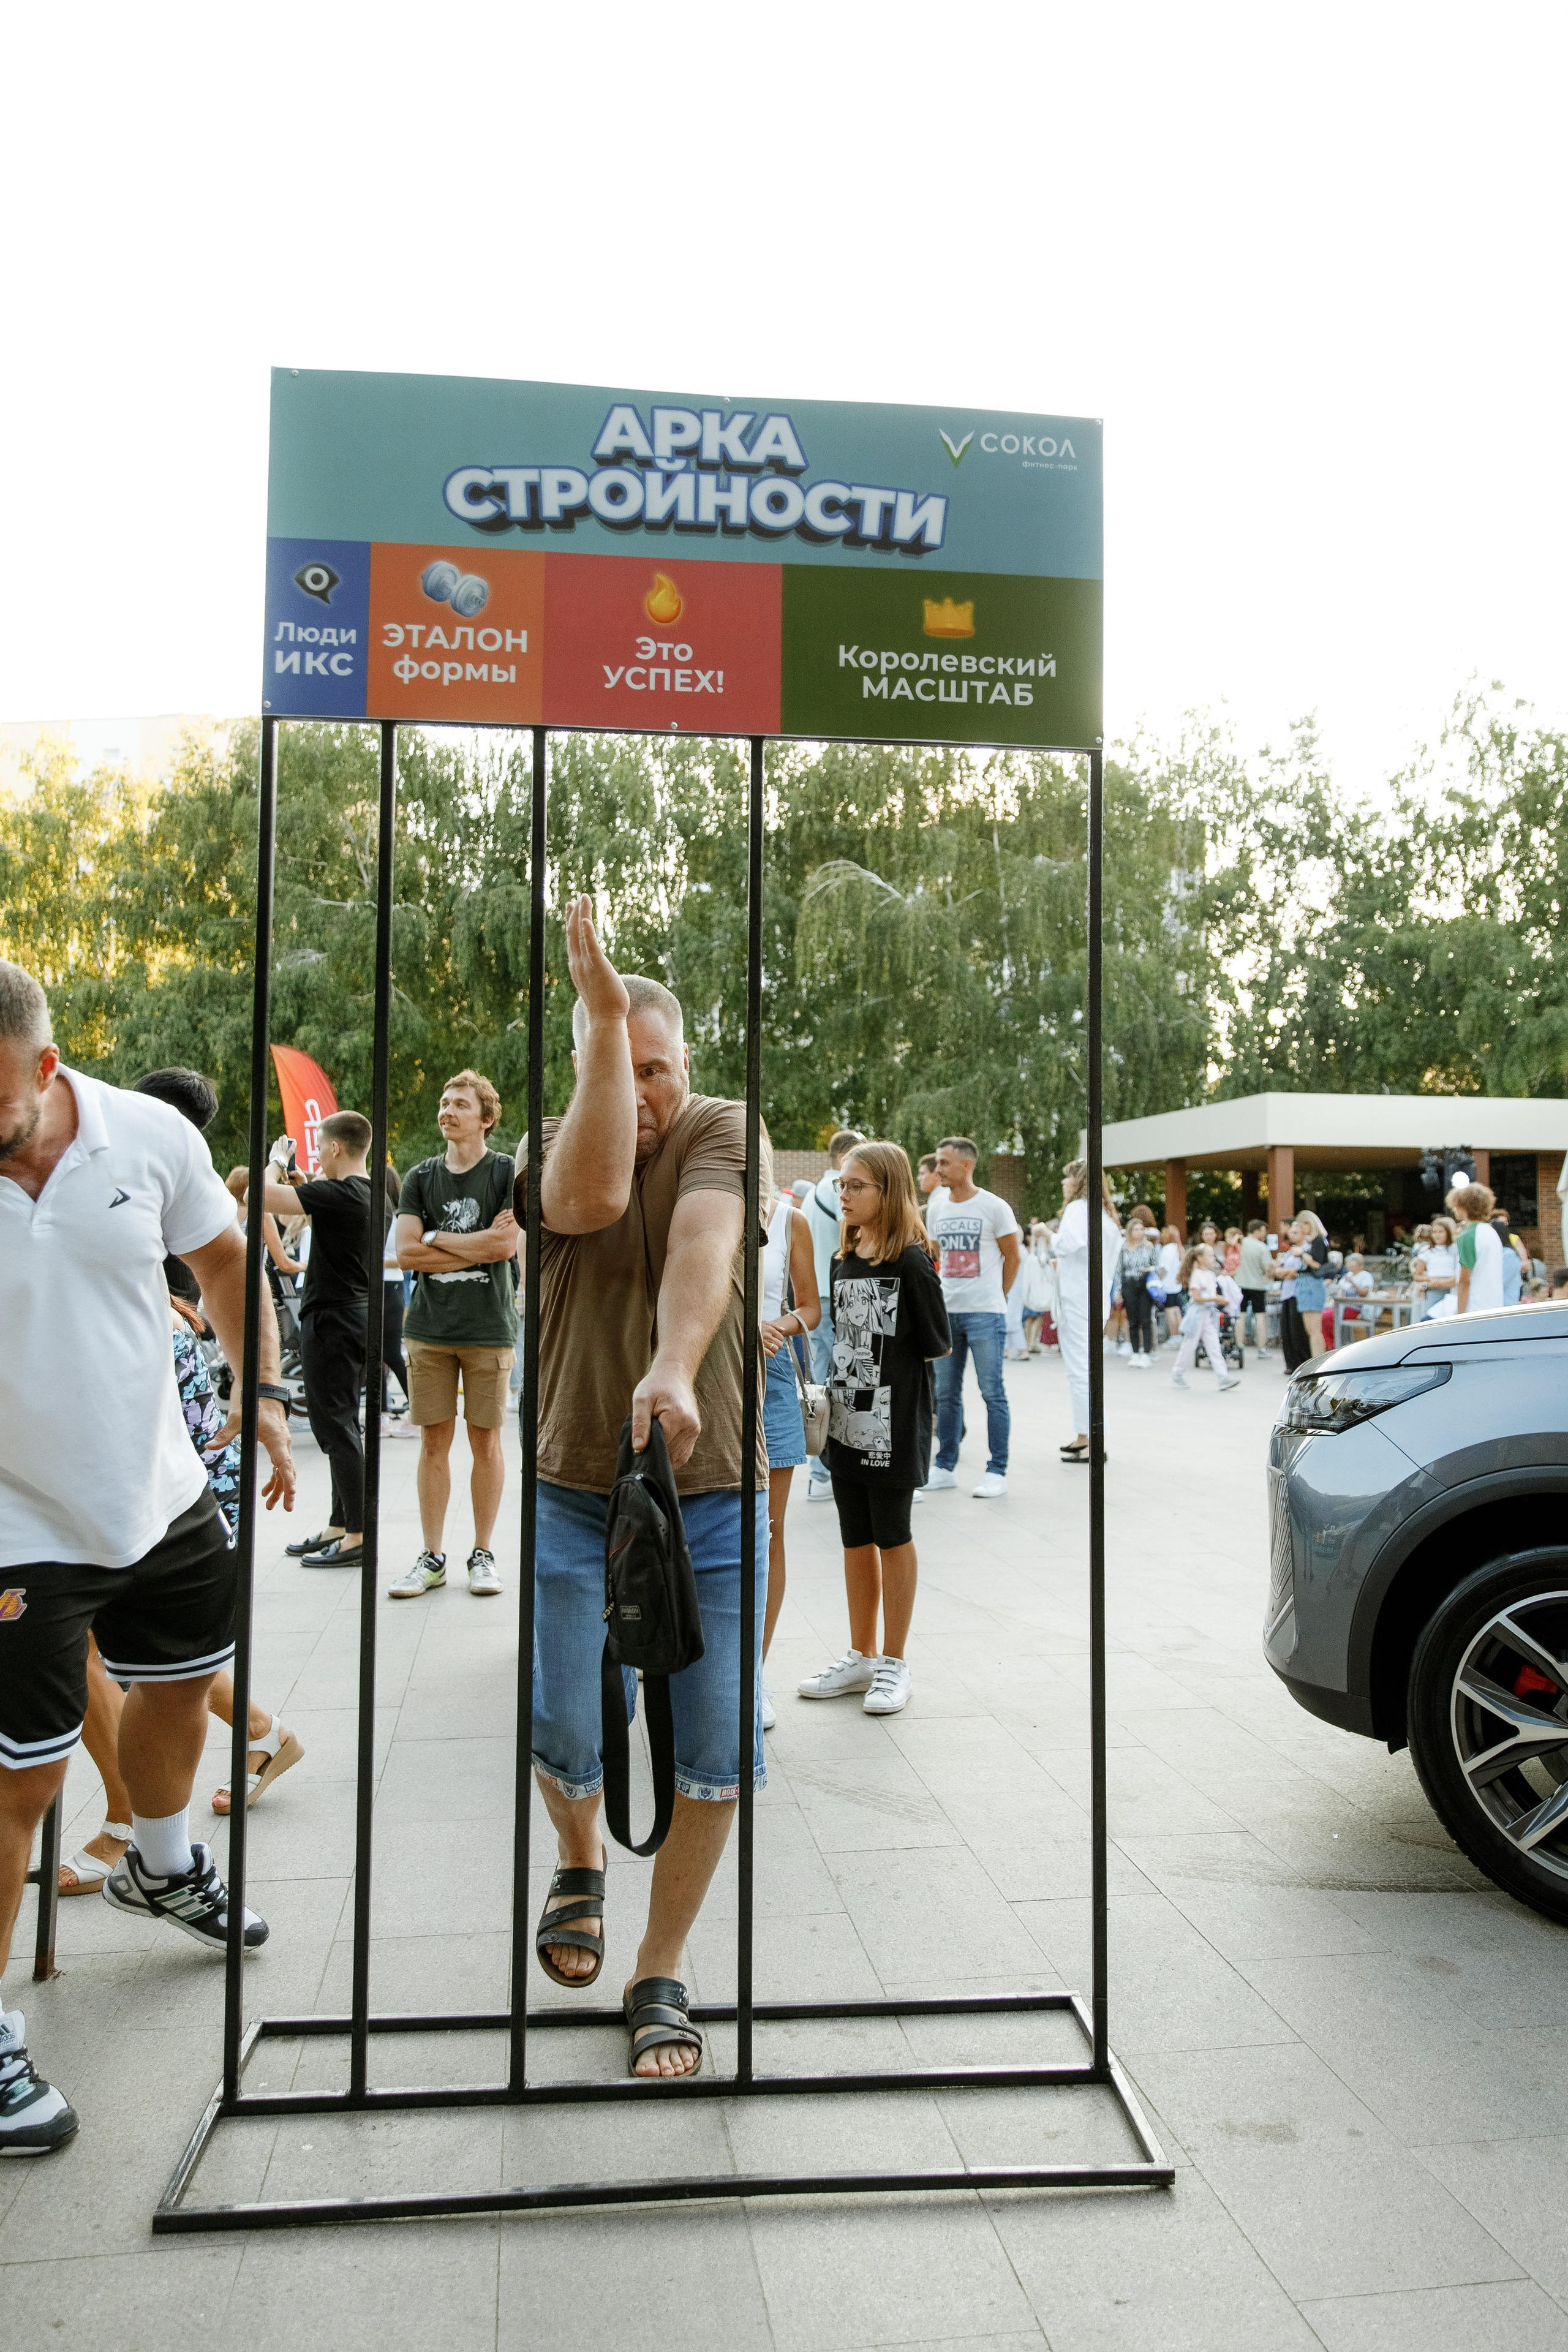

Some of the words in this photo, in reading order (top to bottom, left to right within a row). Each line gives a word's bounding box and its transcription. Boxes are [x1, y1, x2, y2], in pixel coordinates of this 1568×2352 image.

[592, 405, 808, 470] АРКА
[980, 432, 1076, 458] СОКОЛ
[444, 458, 949, 548] СТРОЙНОСТИ
[273, 621, 356, 646] Люди
[383, 623, 527, 653] ЭТАЛОН
[274, 650, 353, 676] ИКС
[635, 636, 693, 662] Это
[839, 644, 1057, 677] Королевский
[393, 654, 516, 686] формы
[603, 665, 723, 693] УСПЕХ!
[863, 676, 1034, 706] МАСШТАБ
[939, 1235, 978, 1250] ONLY
